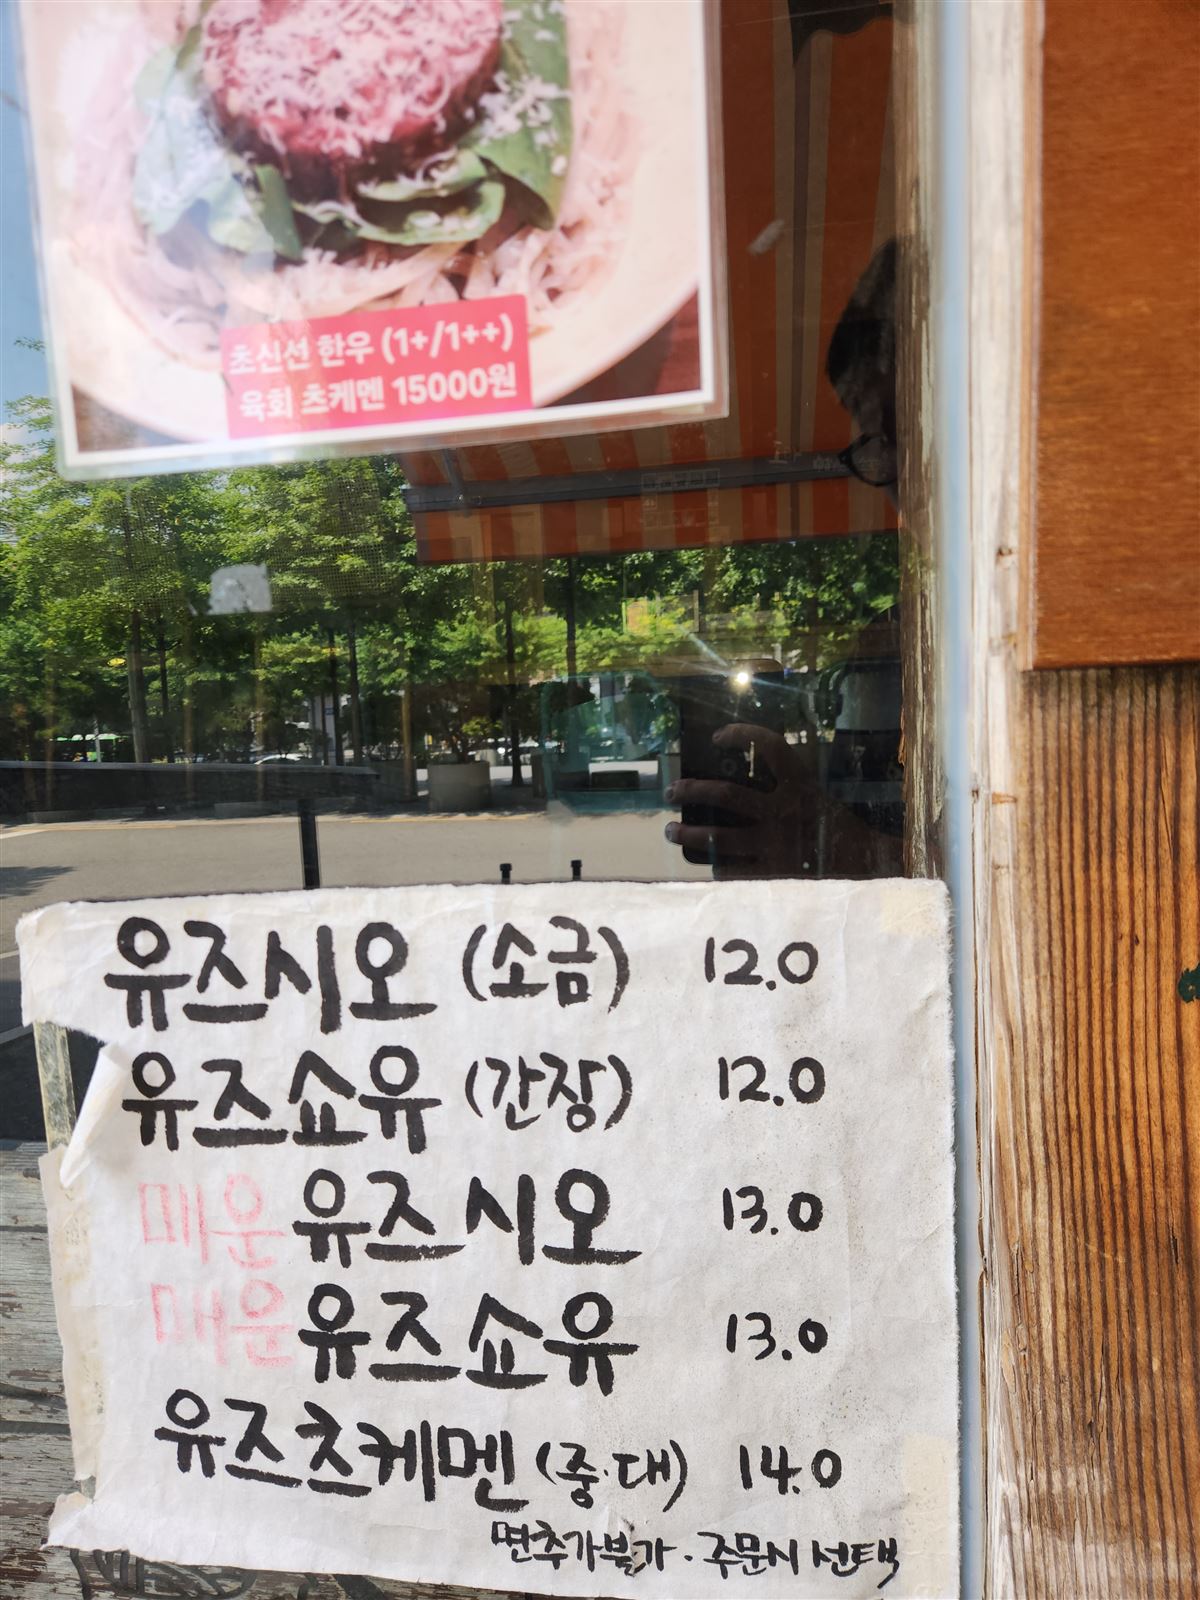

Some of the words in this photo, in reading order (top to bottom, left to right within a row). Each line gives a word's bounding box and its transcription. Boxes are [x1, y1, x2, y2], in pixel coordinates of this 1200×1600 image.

[228, 336, 310, 376] 초신선
[317, 330, 375, 367] 한우
[381, 312, 514, 365] (1+/1++)
[240, 385, 294, 421] 육회
[300, 375, 386, 416] 츠케멘
[391, 361, 518, 406] 15000원
[104, 916, 438, 1035] 유즈시오
[462, 916, 630, 1014] (소금)
[704, 936, 819, 991] 12.0
[121, 1044, 443, 1155] 유즈쇼유
[465, 1052, 633, 1133] (간장)
[718, 1055, 826, 1107] 12.0
[138, 1173, 288, 1270] 매운
[292, 1167, 643, 1269] 유즈시오
[722, 1185, 824, 1236] 13.0
[150, 1279, 295, 1366] 매운
[298, 1282, 640, 1398] 유즈쇼유
[726, 1311, 829, 1361] 13.0
[154, 1388, 530, 1514] 유즈츠케멘
[739, 1444, 842, 1495] 14.0
[697, 1530, 800, 1580] 주문시
[811, 1537, 900, 1590] 선택
